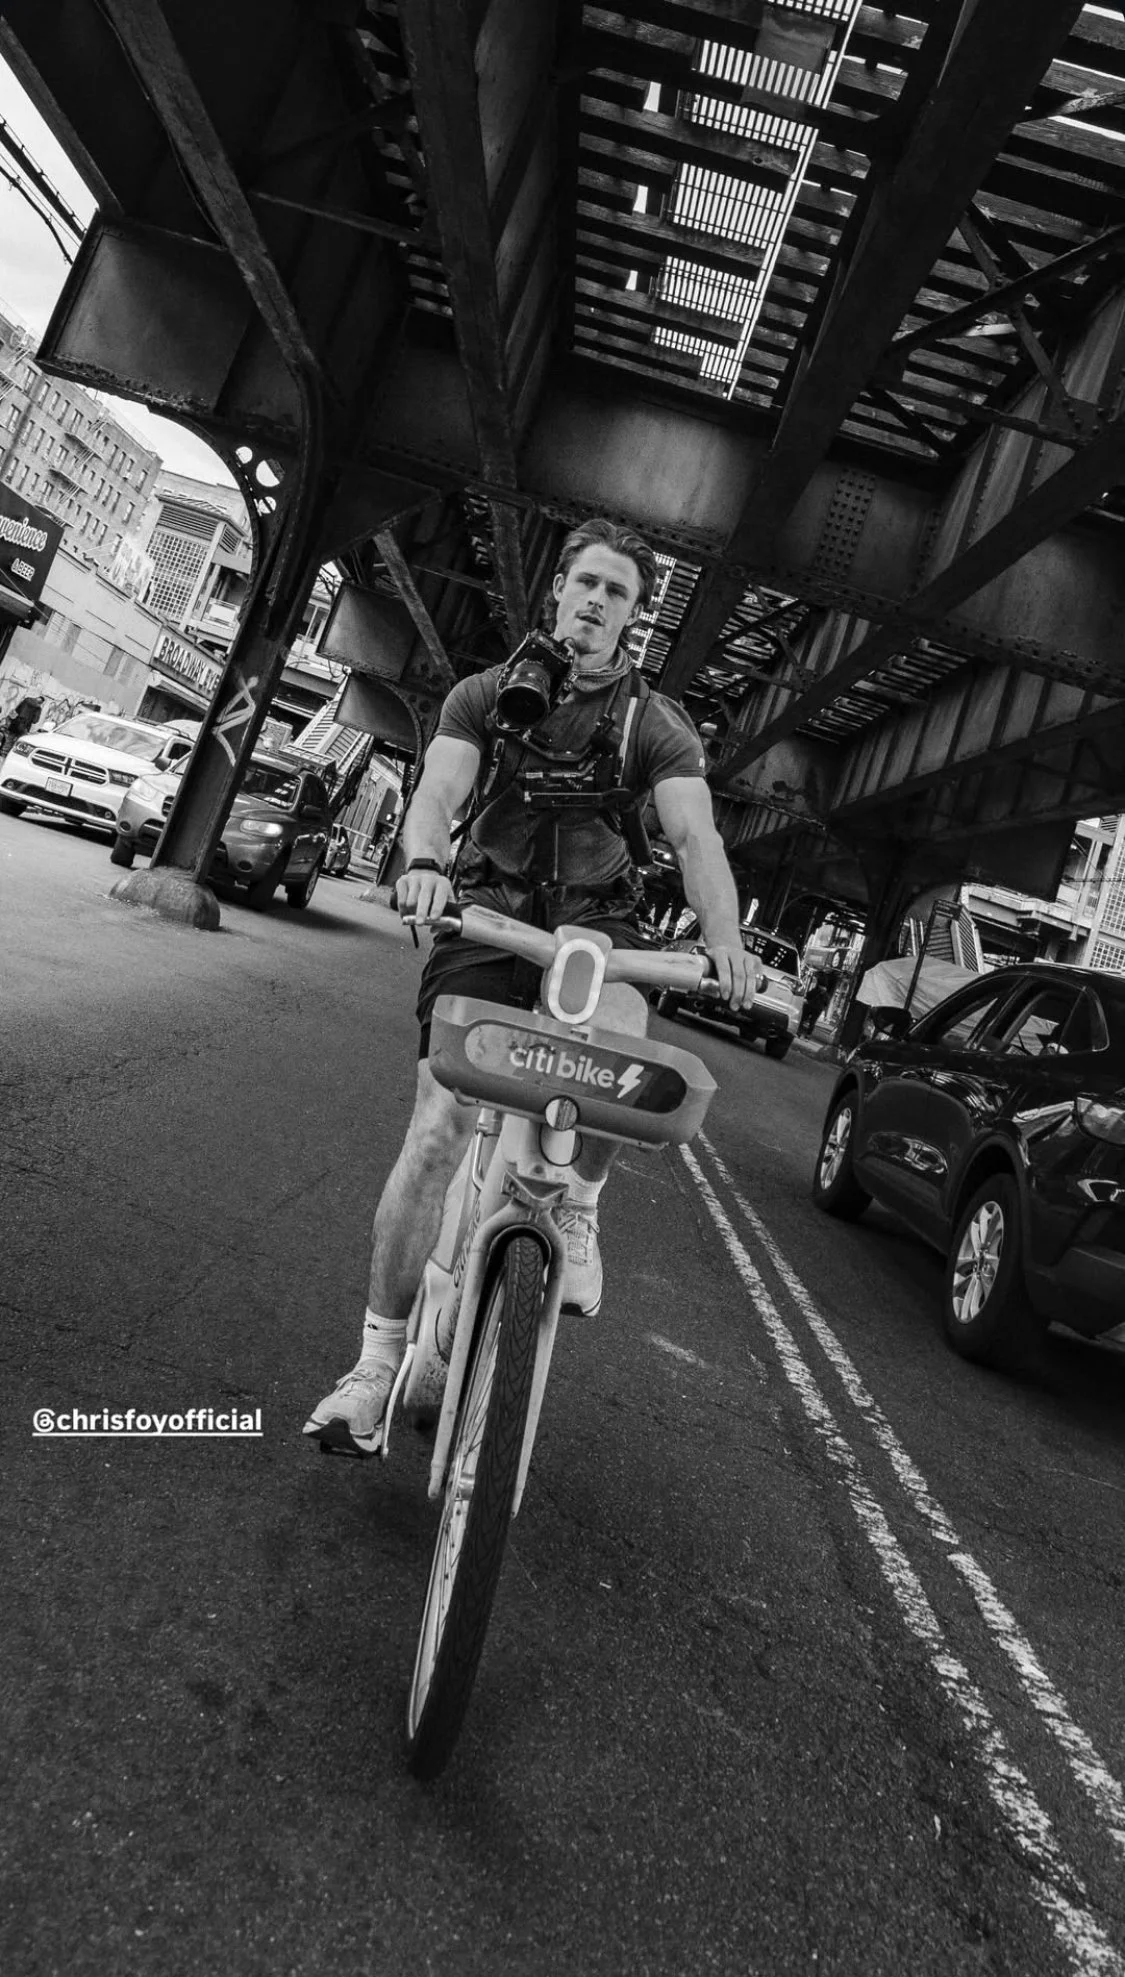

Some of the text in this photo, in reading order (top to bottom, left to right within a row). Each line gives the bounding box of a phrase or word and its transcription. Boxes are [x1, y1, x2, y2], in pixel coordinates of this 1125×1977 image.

[0, 516, 48, 552] venience
[159, 636, 208, 683] BROADWAY
[509, 1045, 615, 1088] citi bike
